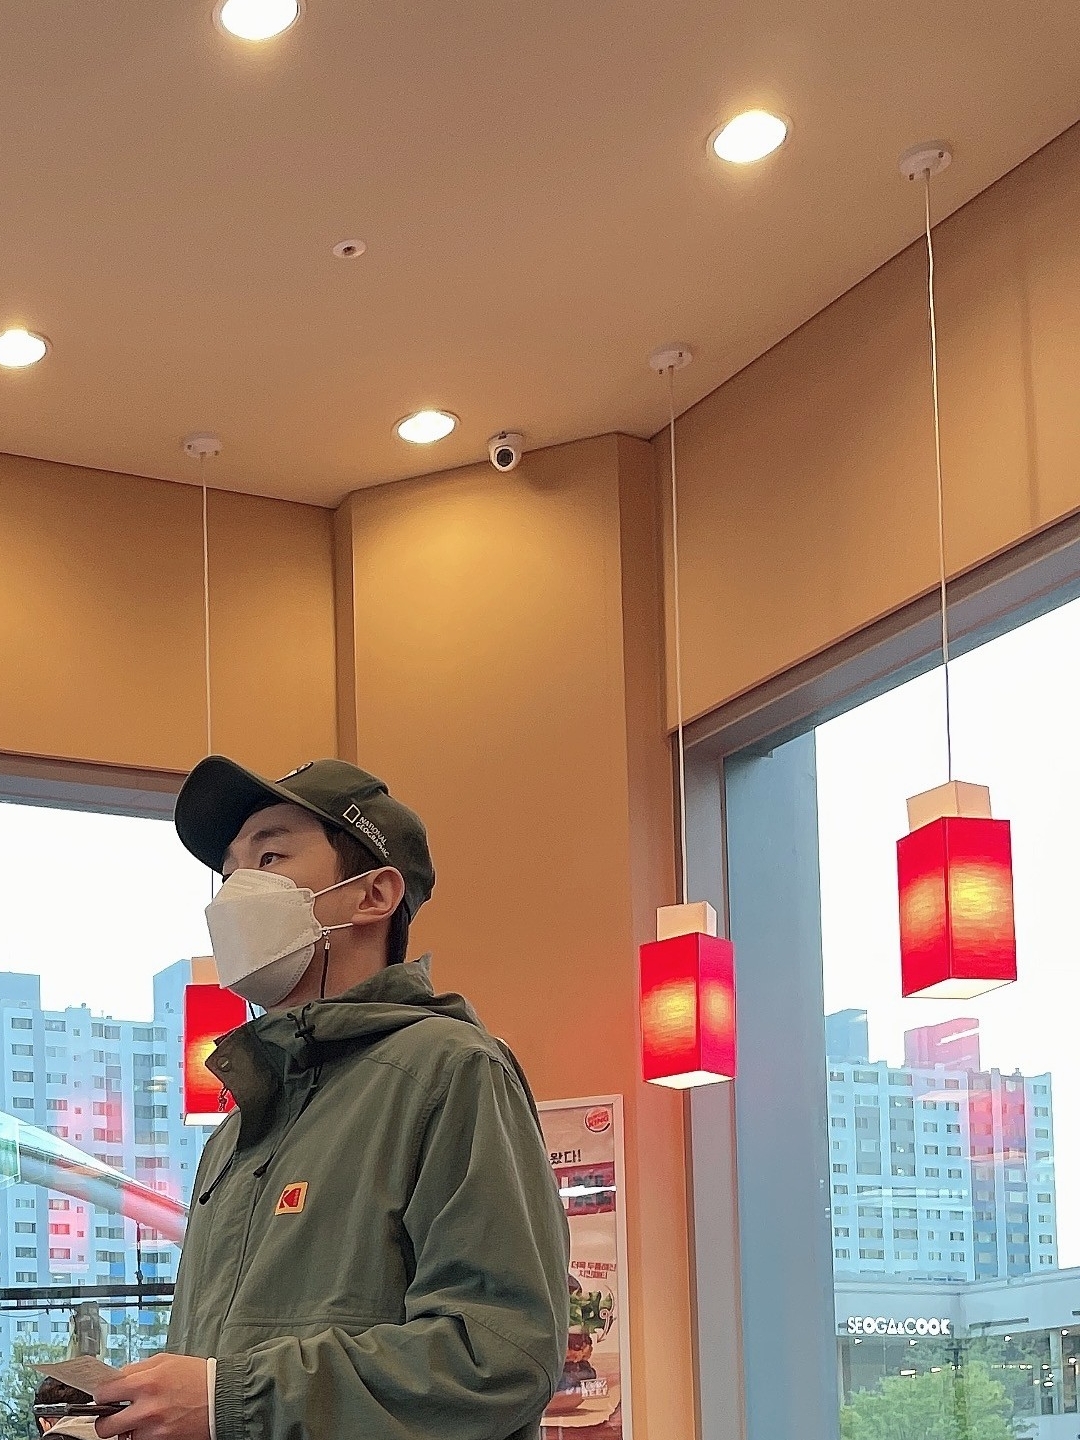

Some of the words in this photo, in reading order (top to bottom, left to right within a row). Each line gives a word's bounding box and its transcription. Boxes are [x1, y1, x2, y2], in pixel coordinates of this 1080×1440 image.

[355, 821, 389, 858] GEOGRAPHIC
[359, 816, 387, 845] NATIONAL
[847, 1316, 951, 1335] SEOGA&COOK
